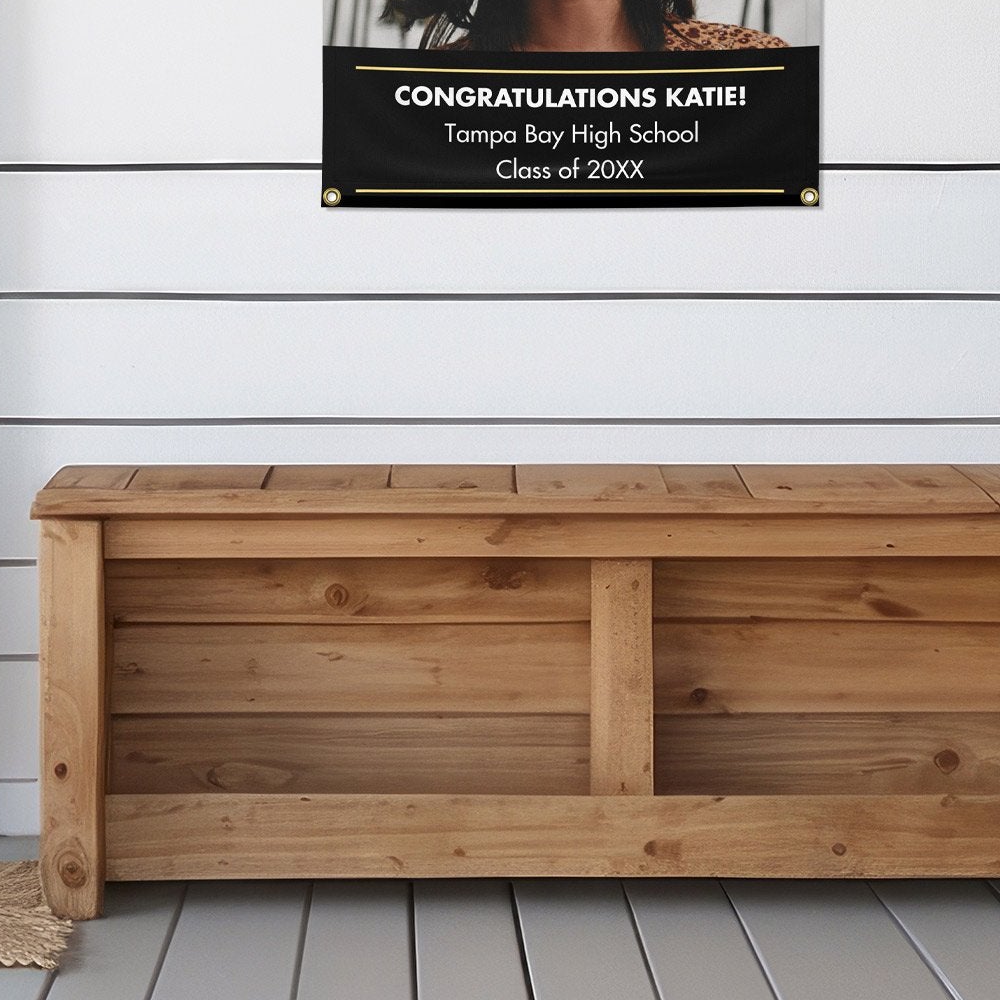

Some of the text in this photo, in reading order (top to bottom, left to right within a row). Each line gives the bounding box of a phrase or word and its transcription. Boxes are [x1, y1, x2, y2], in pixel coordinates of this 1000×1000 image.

[394, 85, 747, 109] CONGRATULATIONS KATIE!
[443, 120, 699, 150] Tampa Bay High School
[495, 156, 645, 180] Class of 20XX
